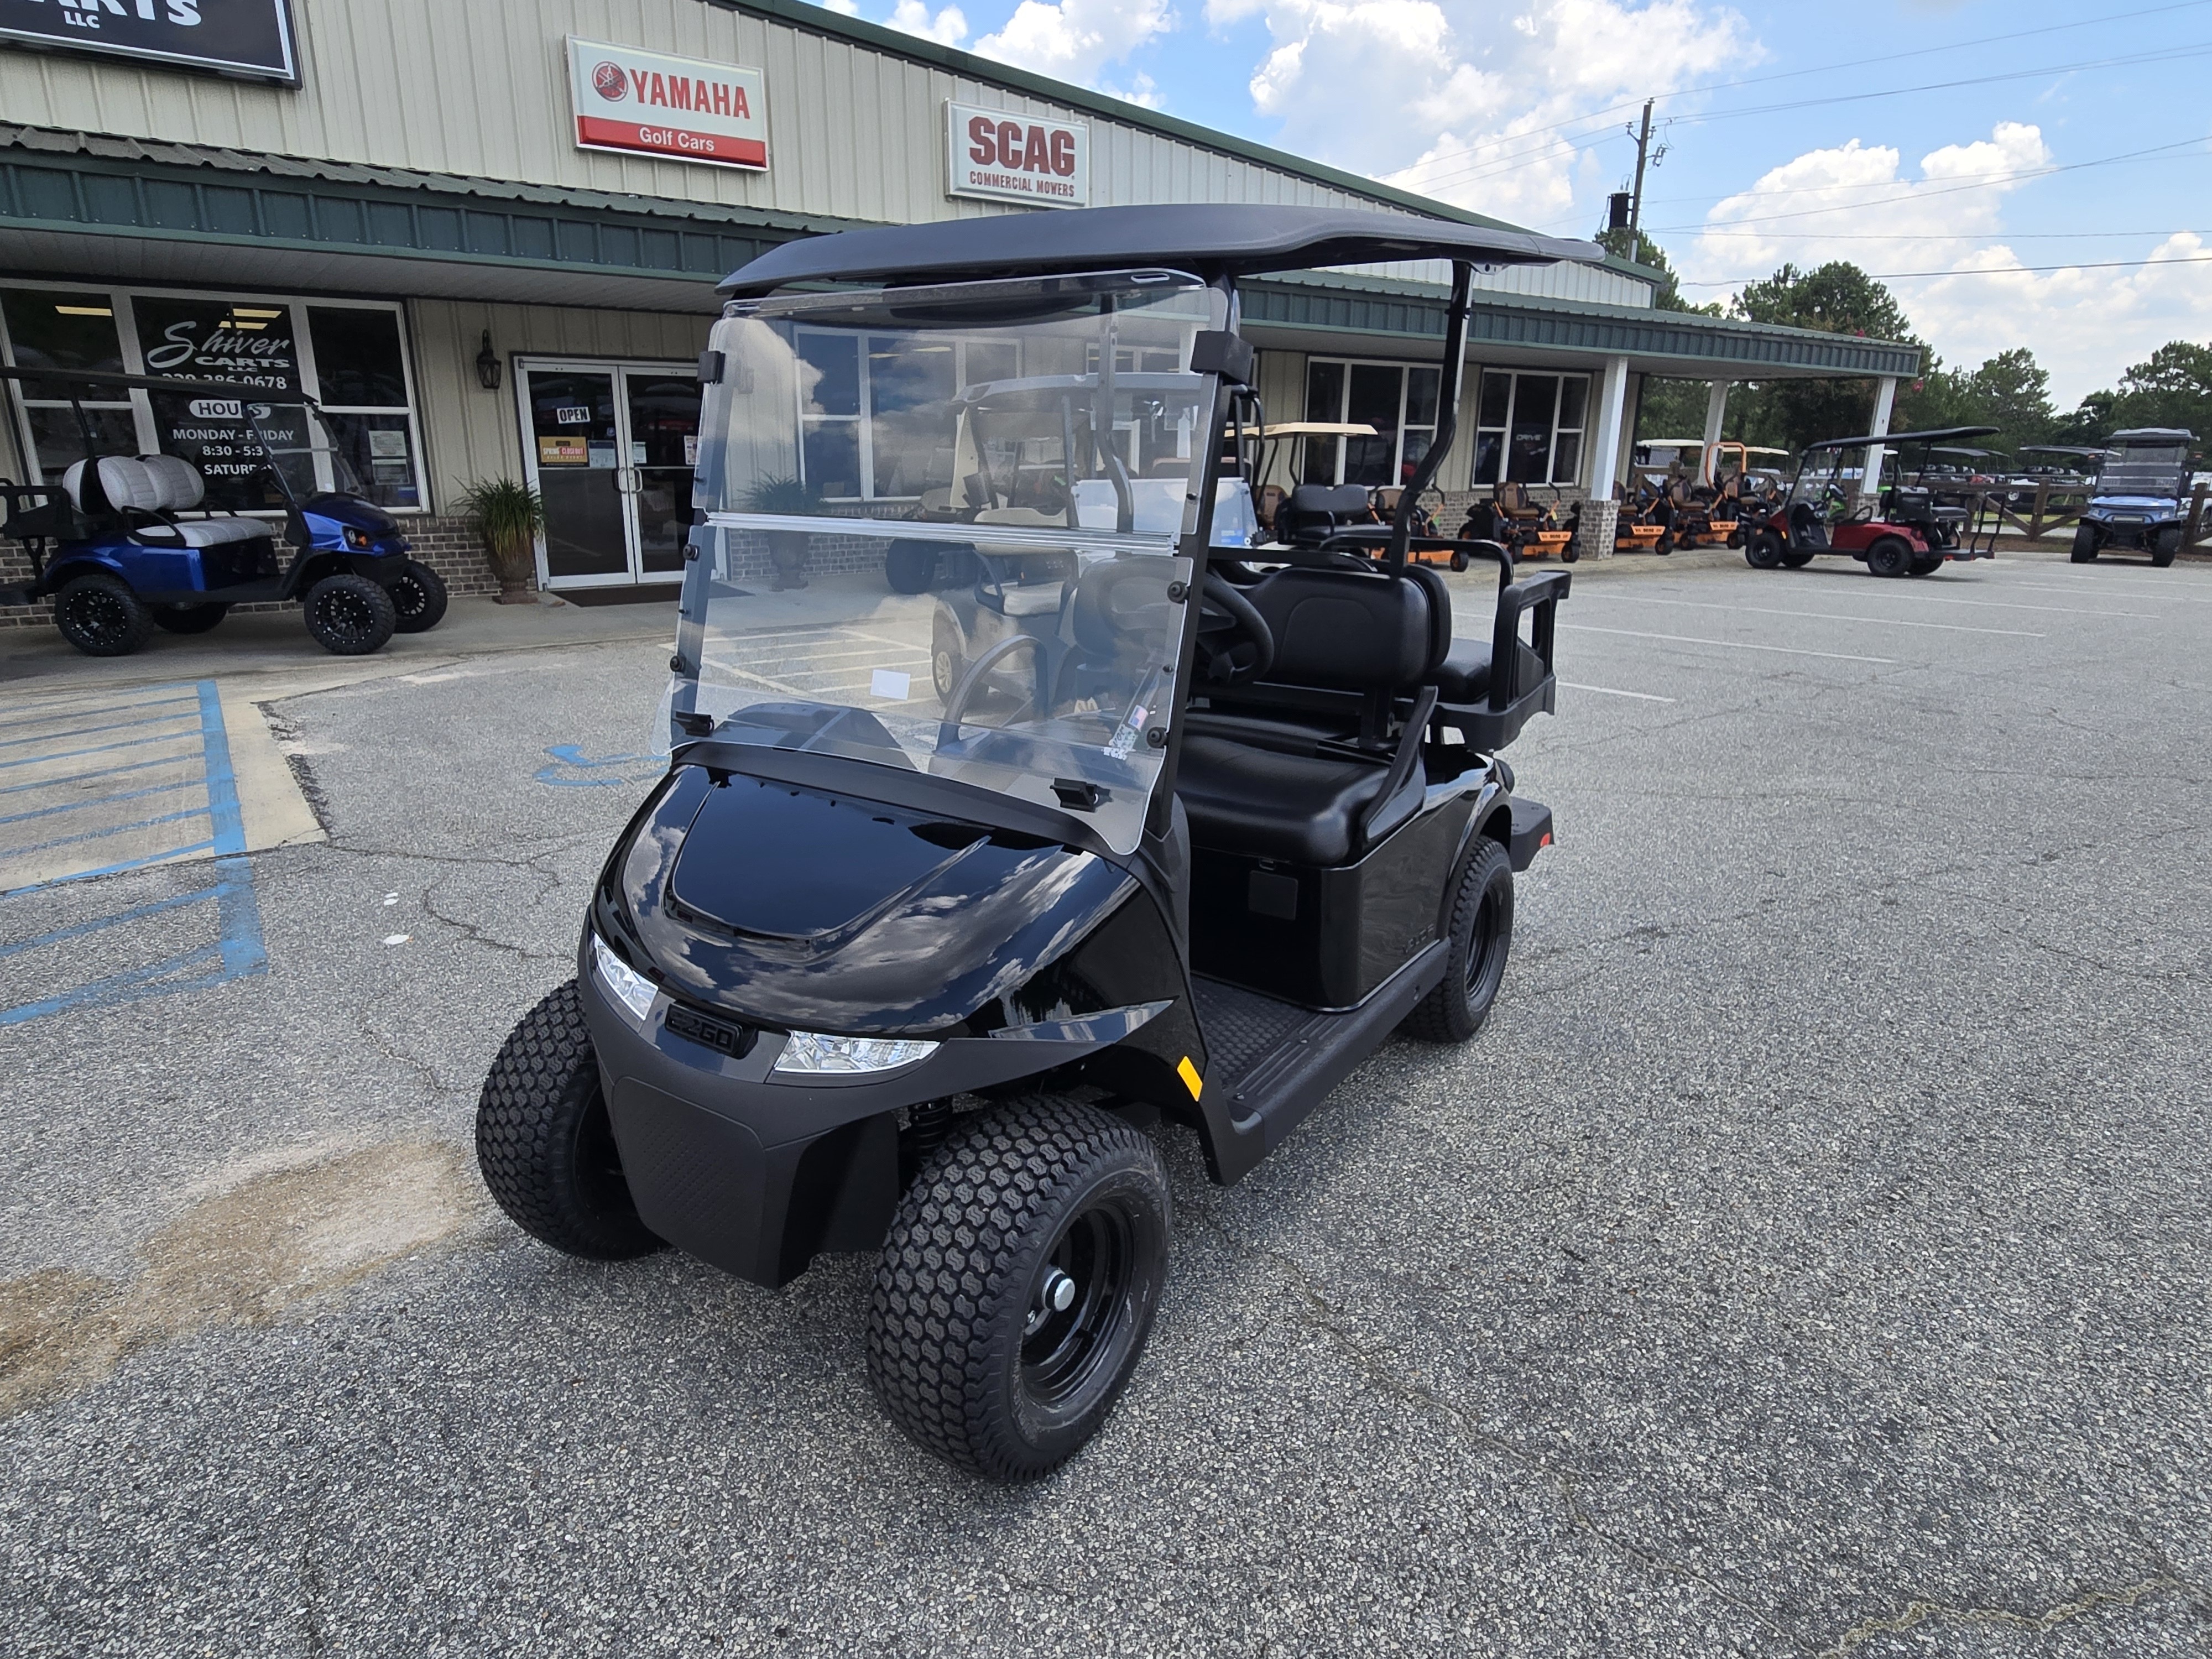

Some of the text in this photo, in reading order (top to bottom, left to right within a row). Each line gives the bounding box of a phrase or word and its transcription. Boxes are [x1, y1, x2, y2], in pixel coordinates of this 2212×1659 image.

[64, 11, 100, 28] LLC
[629, 69, 750, 119] YAMAHA
[639, 127, 714, 152] Golf Cars
[969, 116, 1075, 177] SCAG
[970, 171, 1074, 197] COMMERCIAL MOWERS
[147, 321, 290, 368] Shiver
[195, 357, 290, 368] CARTS
[198, 403, 262, 416] HOUS
[559, 409, 588, 421] OPEN
[173, 429, 235, 440] MONDAY
[246, 430, 294, 440] FIDAY
[202, 446, 232, 456] 8:30
[243, 446, 263, 456] 5:3
